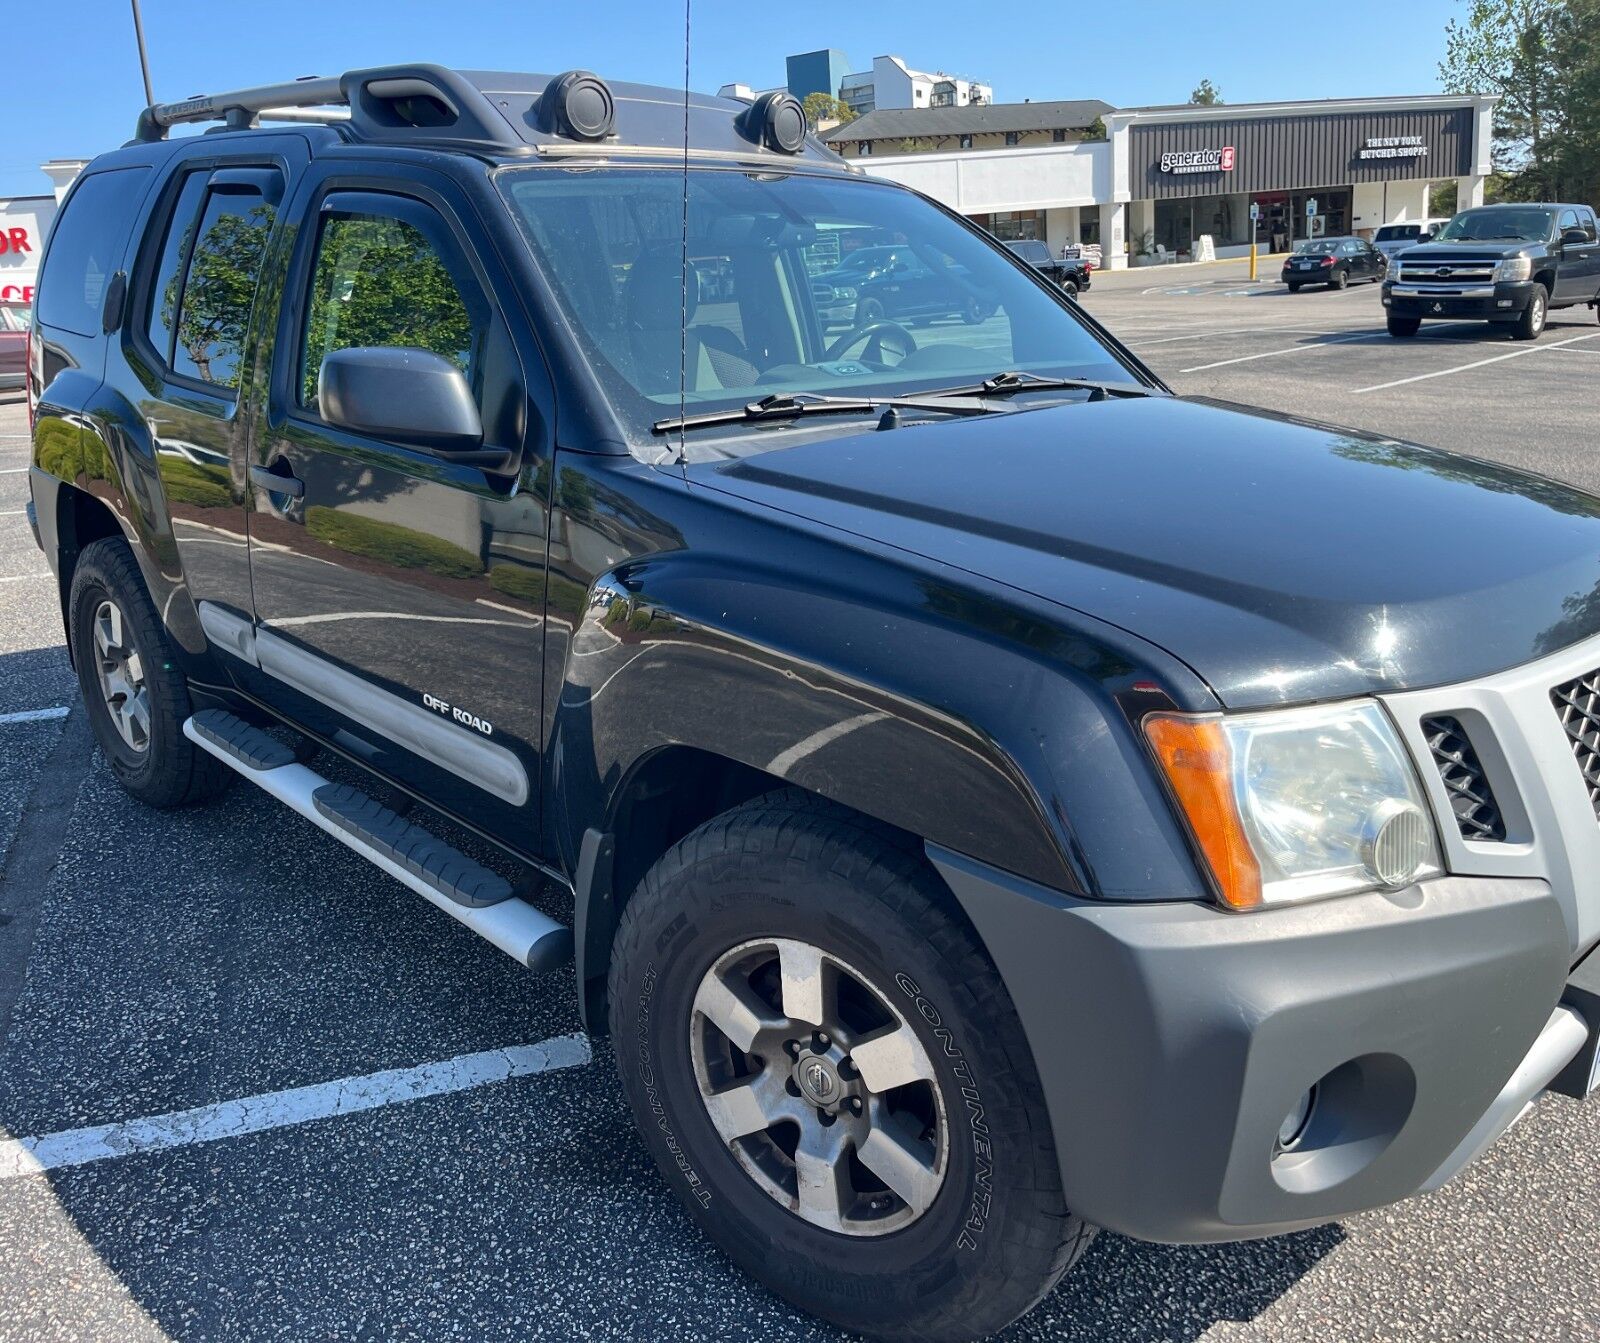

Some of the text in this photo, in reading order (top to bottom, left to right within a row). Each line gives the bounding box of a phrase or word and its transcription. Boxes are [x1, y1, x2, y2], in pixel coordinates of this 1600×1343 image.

[1360, 146, 1428, 159] BUTCHER SHOPPE
[1367, 136, 1422, 148] THE NEW YORK
[1161, 149, 1222, 172] generator
[423, 693, 492, 735] OFF ROAD
[895, 972, 994, 1251] CONTINENTAL
